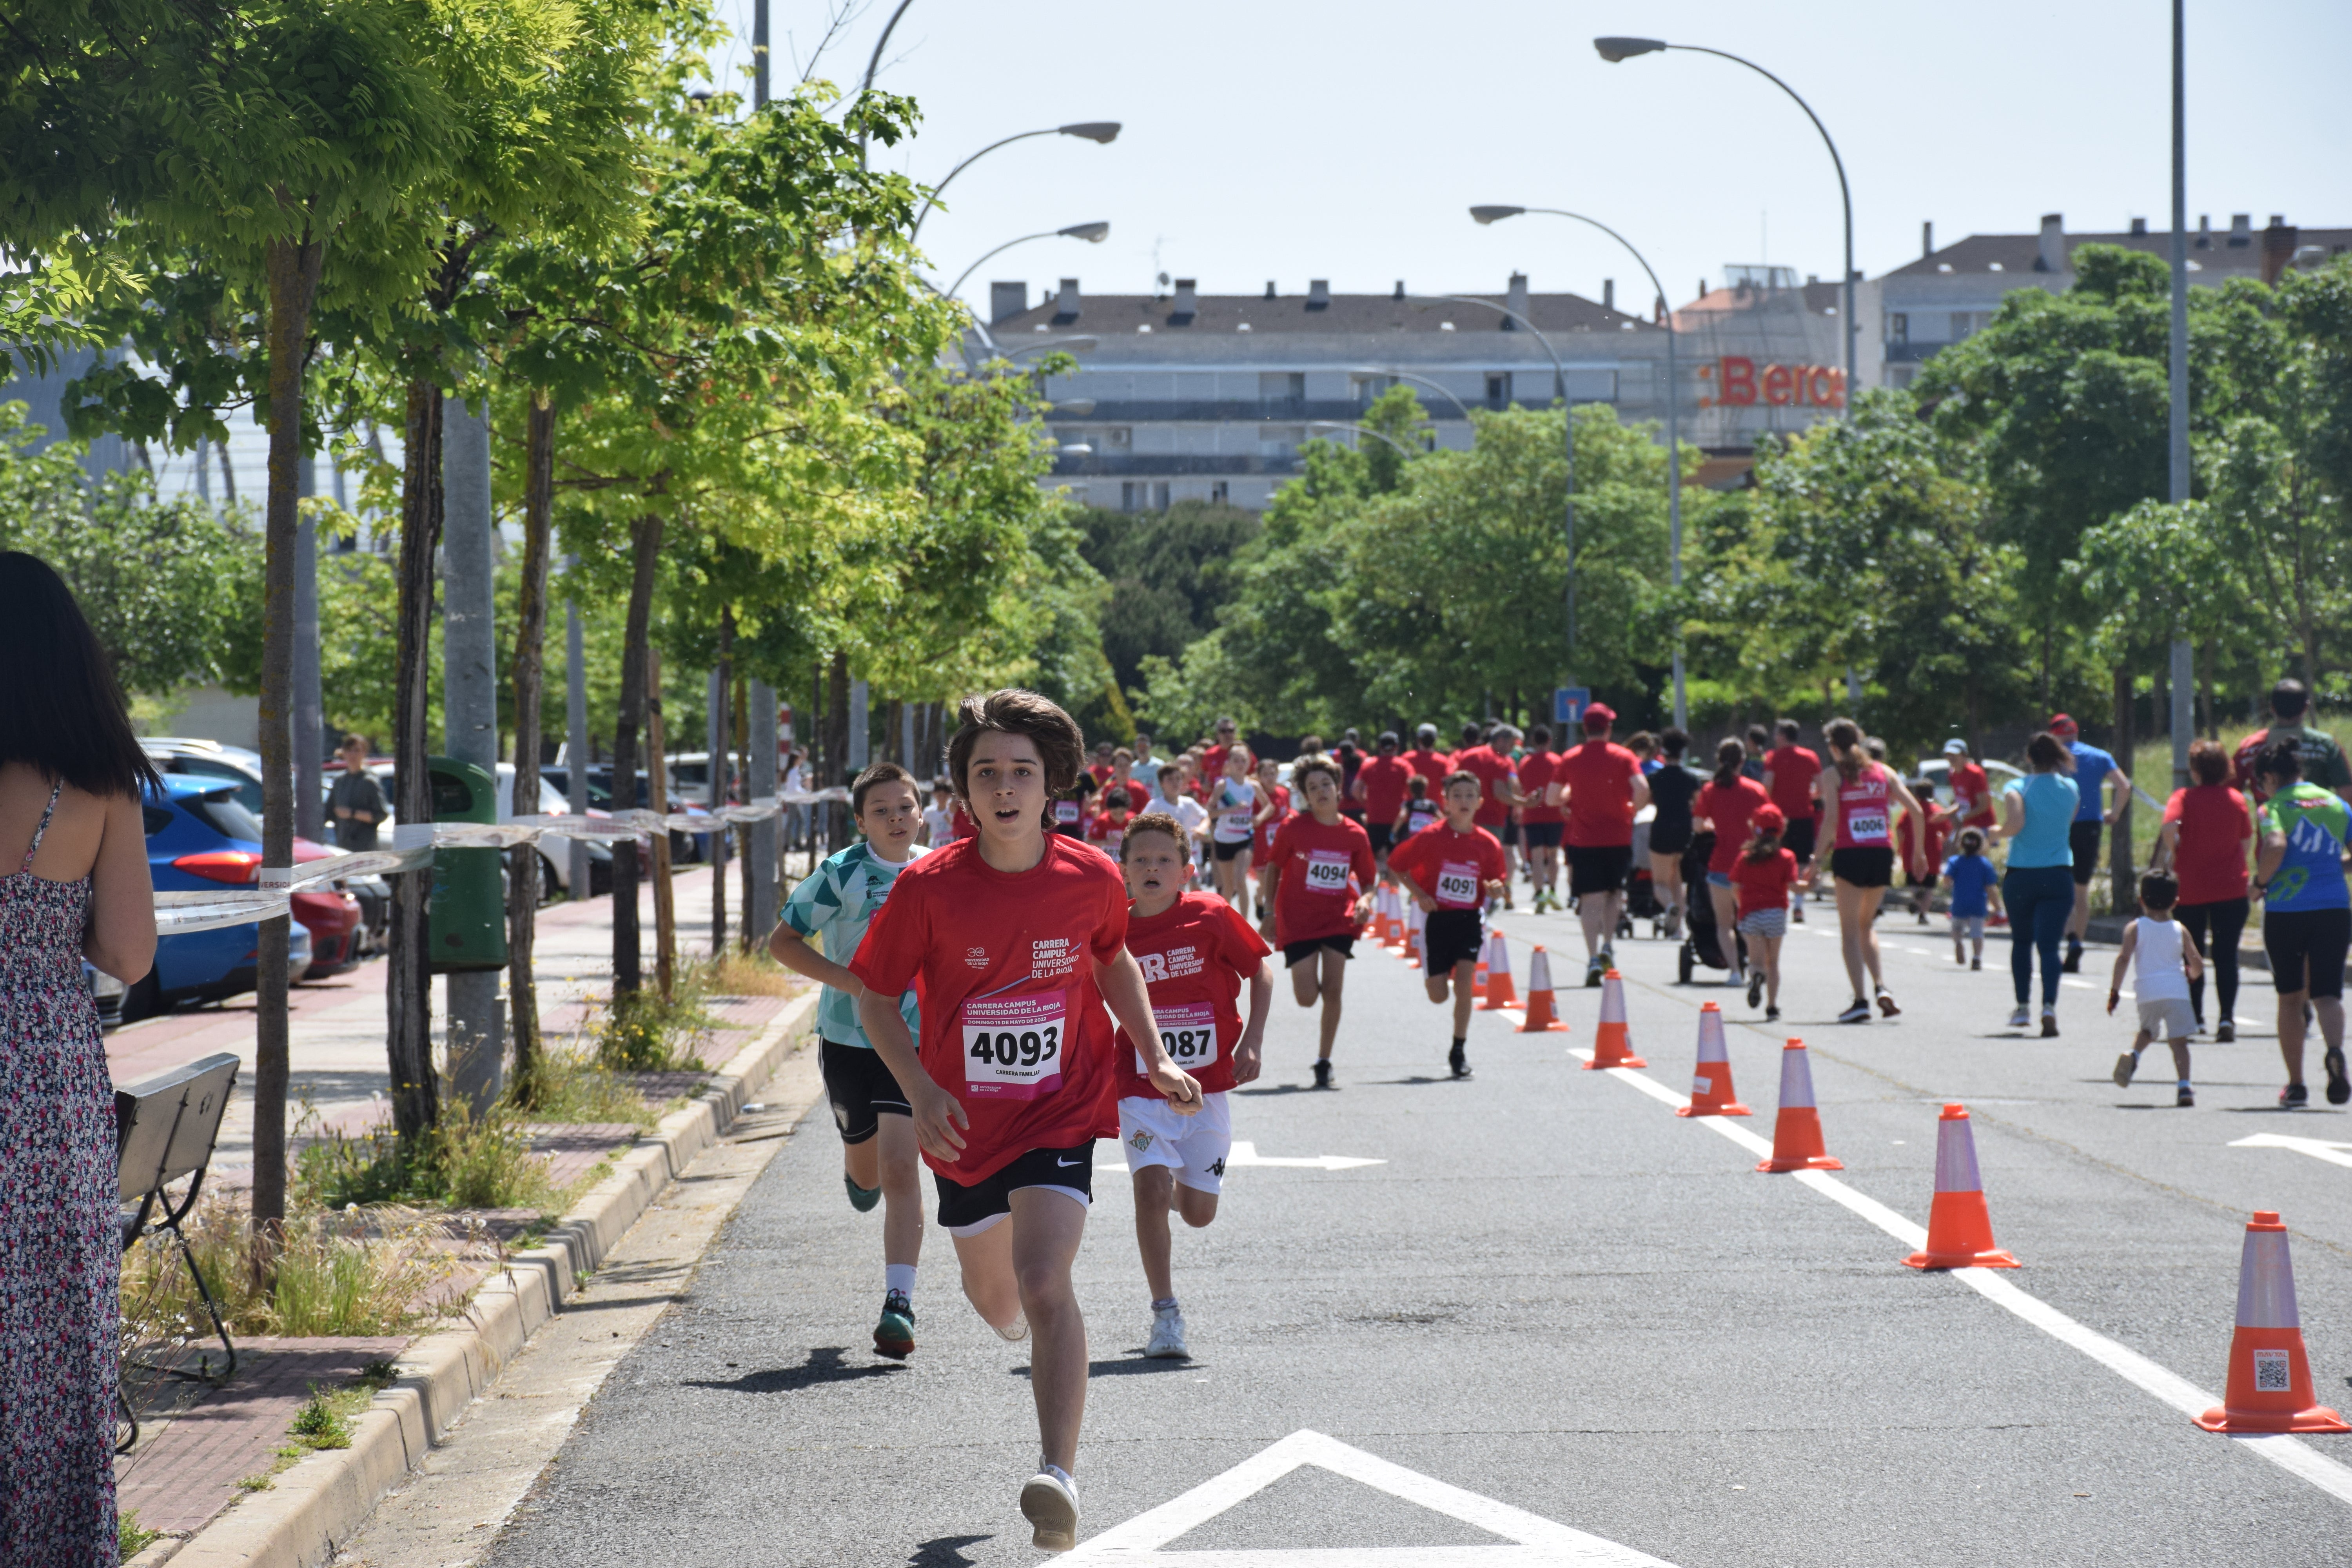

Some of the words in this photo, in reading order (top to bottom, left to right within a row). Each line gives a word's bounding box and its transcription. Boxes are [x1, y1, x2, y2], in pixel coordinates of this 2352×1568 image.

[1853, 819, 1884, 832] 4006
[1310, 864, 1347, 881] 4094
[1033, 938, 1069, 949] CARRERA
[967, 947, 984, 957] 30
[1033, 948, 1066, 960] CAMPUS
[1167, 946, 1196, 956] CARRERA
[1033, 955, 1079, 969] UNIVERSIDAD
[1168, 953, 1194, 964] CAMPUS
[1032, 970, 1043, 978] DE
[1044, 969, 1054, 978] LA
[1055, 965, 1073, 975] RIOJA
[1189, 965, 1202, 974] RIOJA
[1043, 1002, 1060, 1011] RIOJA
[971, 1026, 1058, 1066] 4093
